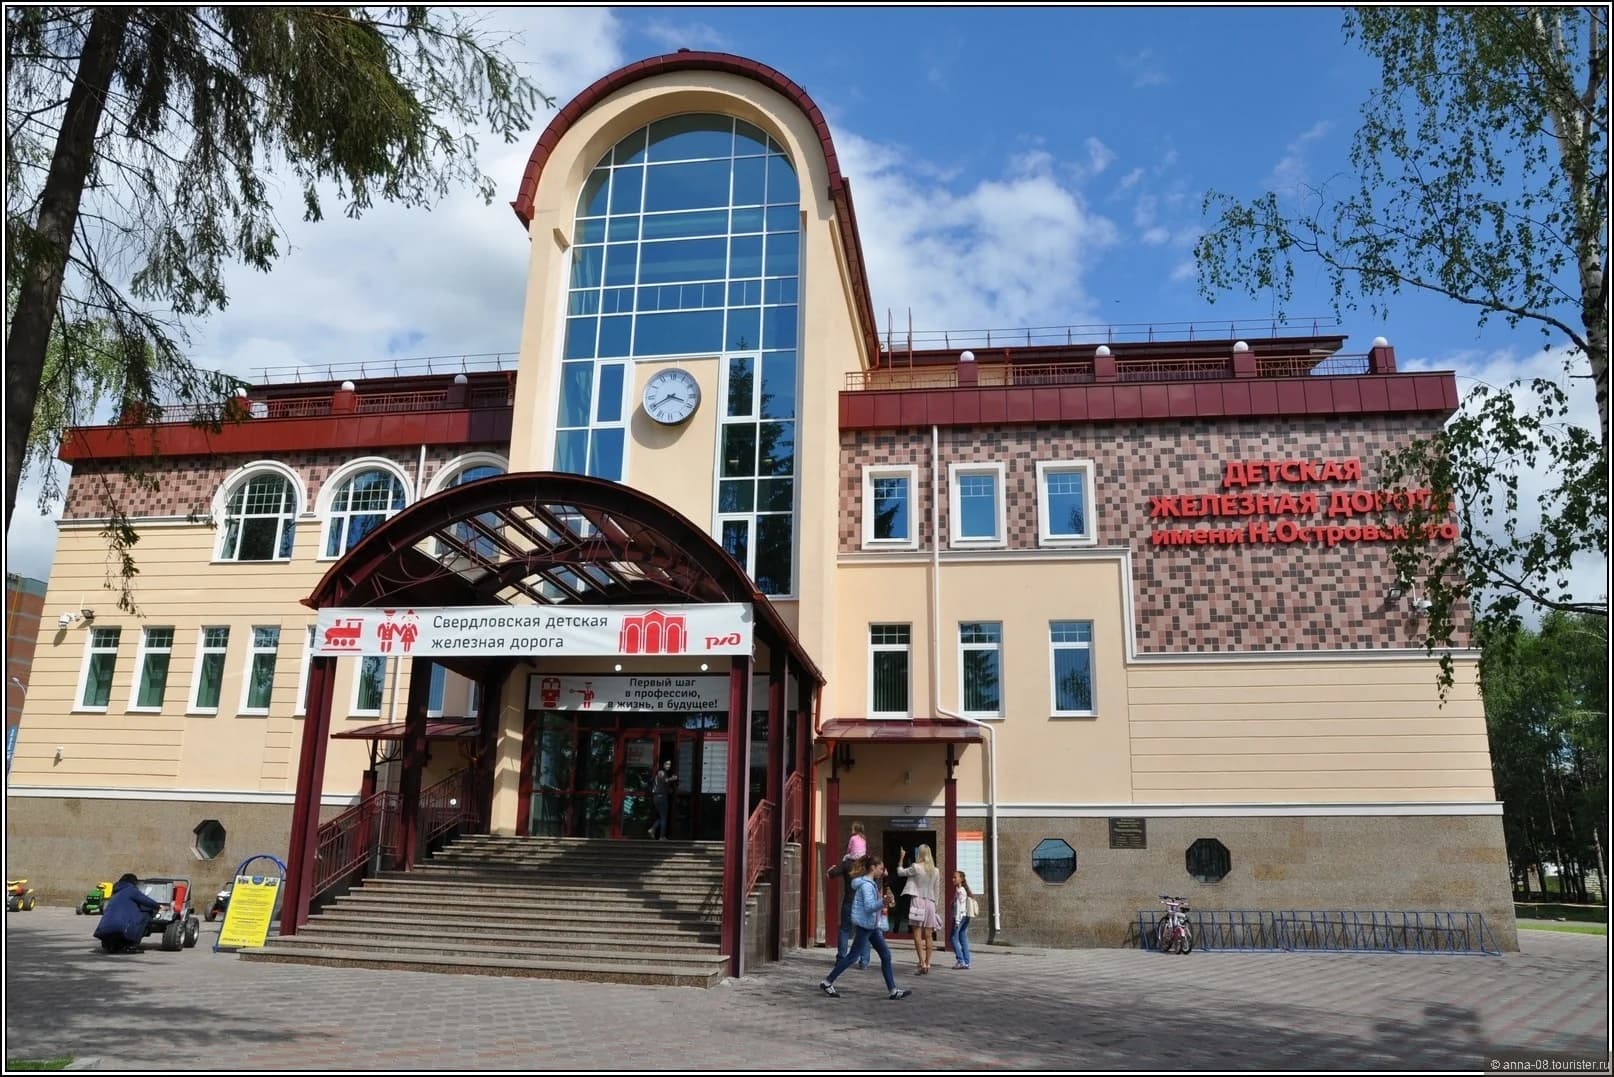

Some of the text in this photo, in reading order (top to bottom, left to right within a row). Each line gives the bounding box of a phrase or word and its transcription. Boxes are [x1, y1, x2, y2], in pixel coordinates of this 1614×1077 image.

[1223, 459, 1361, 488] ДЕТСКАЯ
[1150, 492, 1319, 518] ЖЕЛЕЗНАЯ
[1152, 527, 1245, 545] имени
[432, 615, 608, 631] Свердловская детская
[431, 637, 564, 651] железная дорога
[629, 678, 697, 688] Первый шаг
[634, 688, 701, 699] профессию,
[617, 701, 654, 709] жизнь,
[667, 699, 718, 710] будущее!
